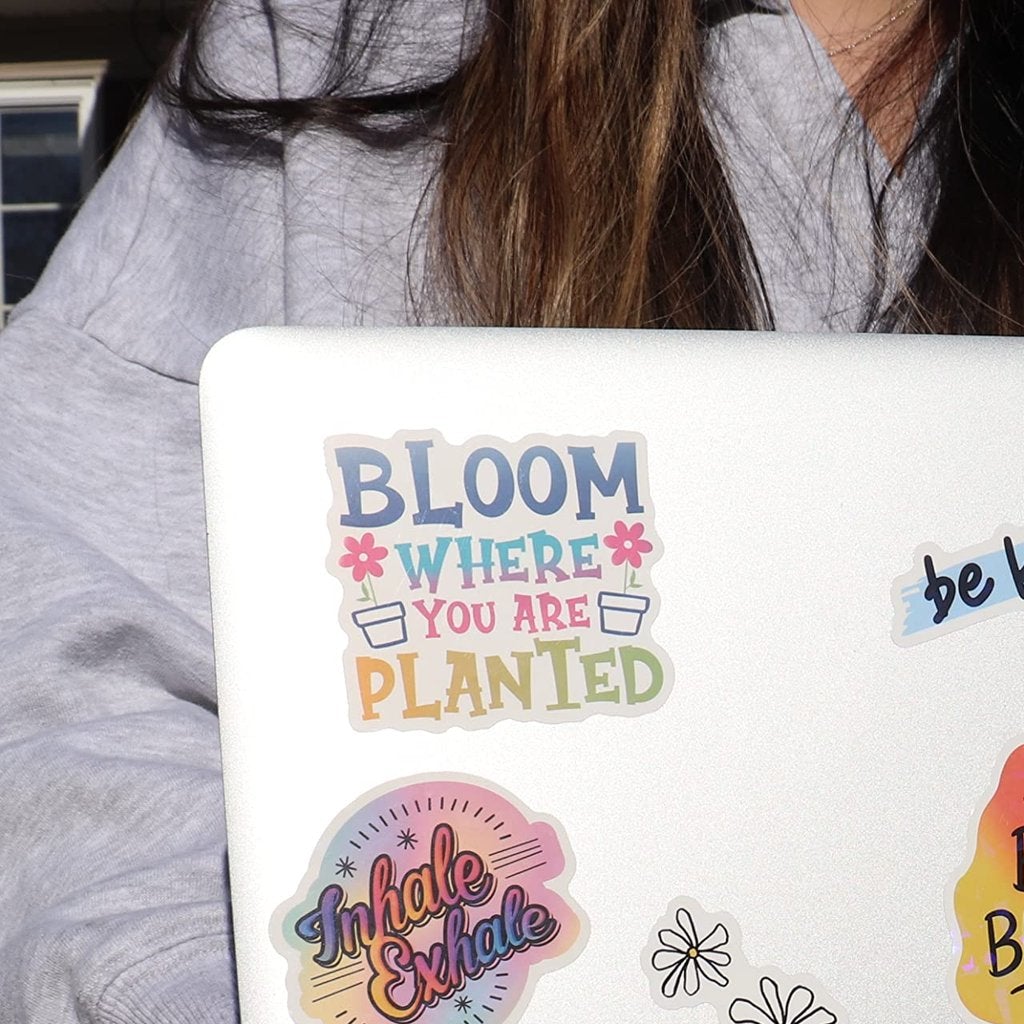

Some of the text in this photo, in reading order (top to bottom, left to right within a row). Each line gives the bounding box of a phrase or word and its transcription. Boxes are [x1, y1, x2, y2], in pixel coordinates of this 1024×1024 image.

[334, 439, 644, 528] BLOOM
[394, 530, 602, 594] WHERE
[924, 555, 995, 624] be
[412, 592, 591, 639] YOU ARE
[355, 636, 664, 721] PLANTED
[295, 822, 497, 967] Inhale
[367, 885, 561, 1024] Exhale
